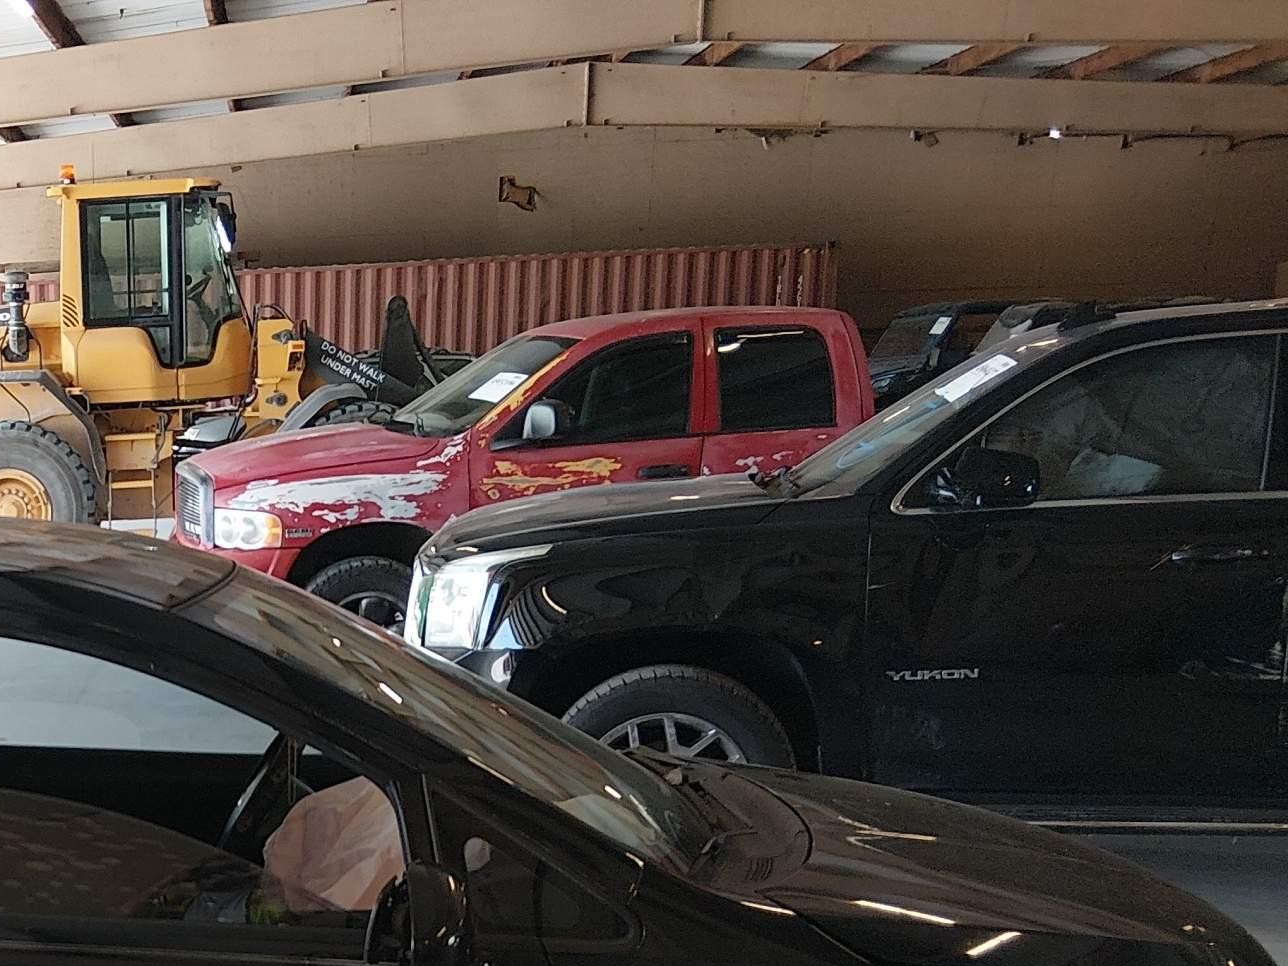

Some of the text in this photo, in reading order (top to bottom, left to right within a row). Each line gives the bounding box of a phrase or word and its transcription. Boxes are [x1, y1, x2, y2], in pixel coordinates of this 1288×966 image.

[320, 341, 386, 383] DO NOT WALK
[320, 354, 377, 390] UNDER MAST
[885, 668, 979, 681] YUKON
